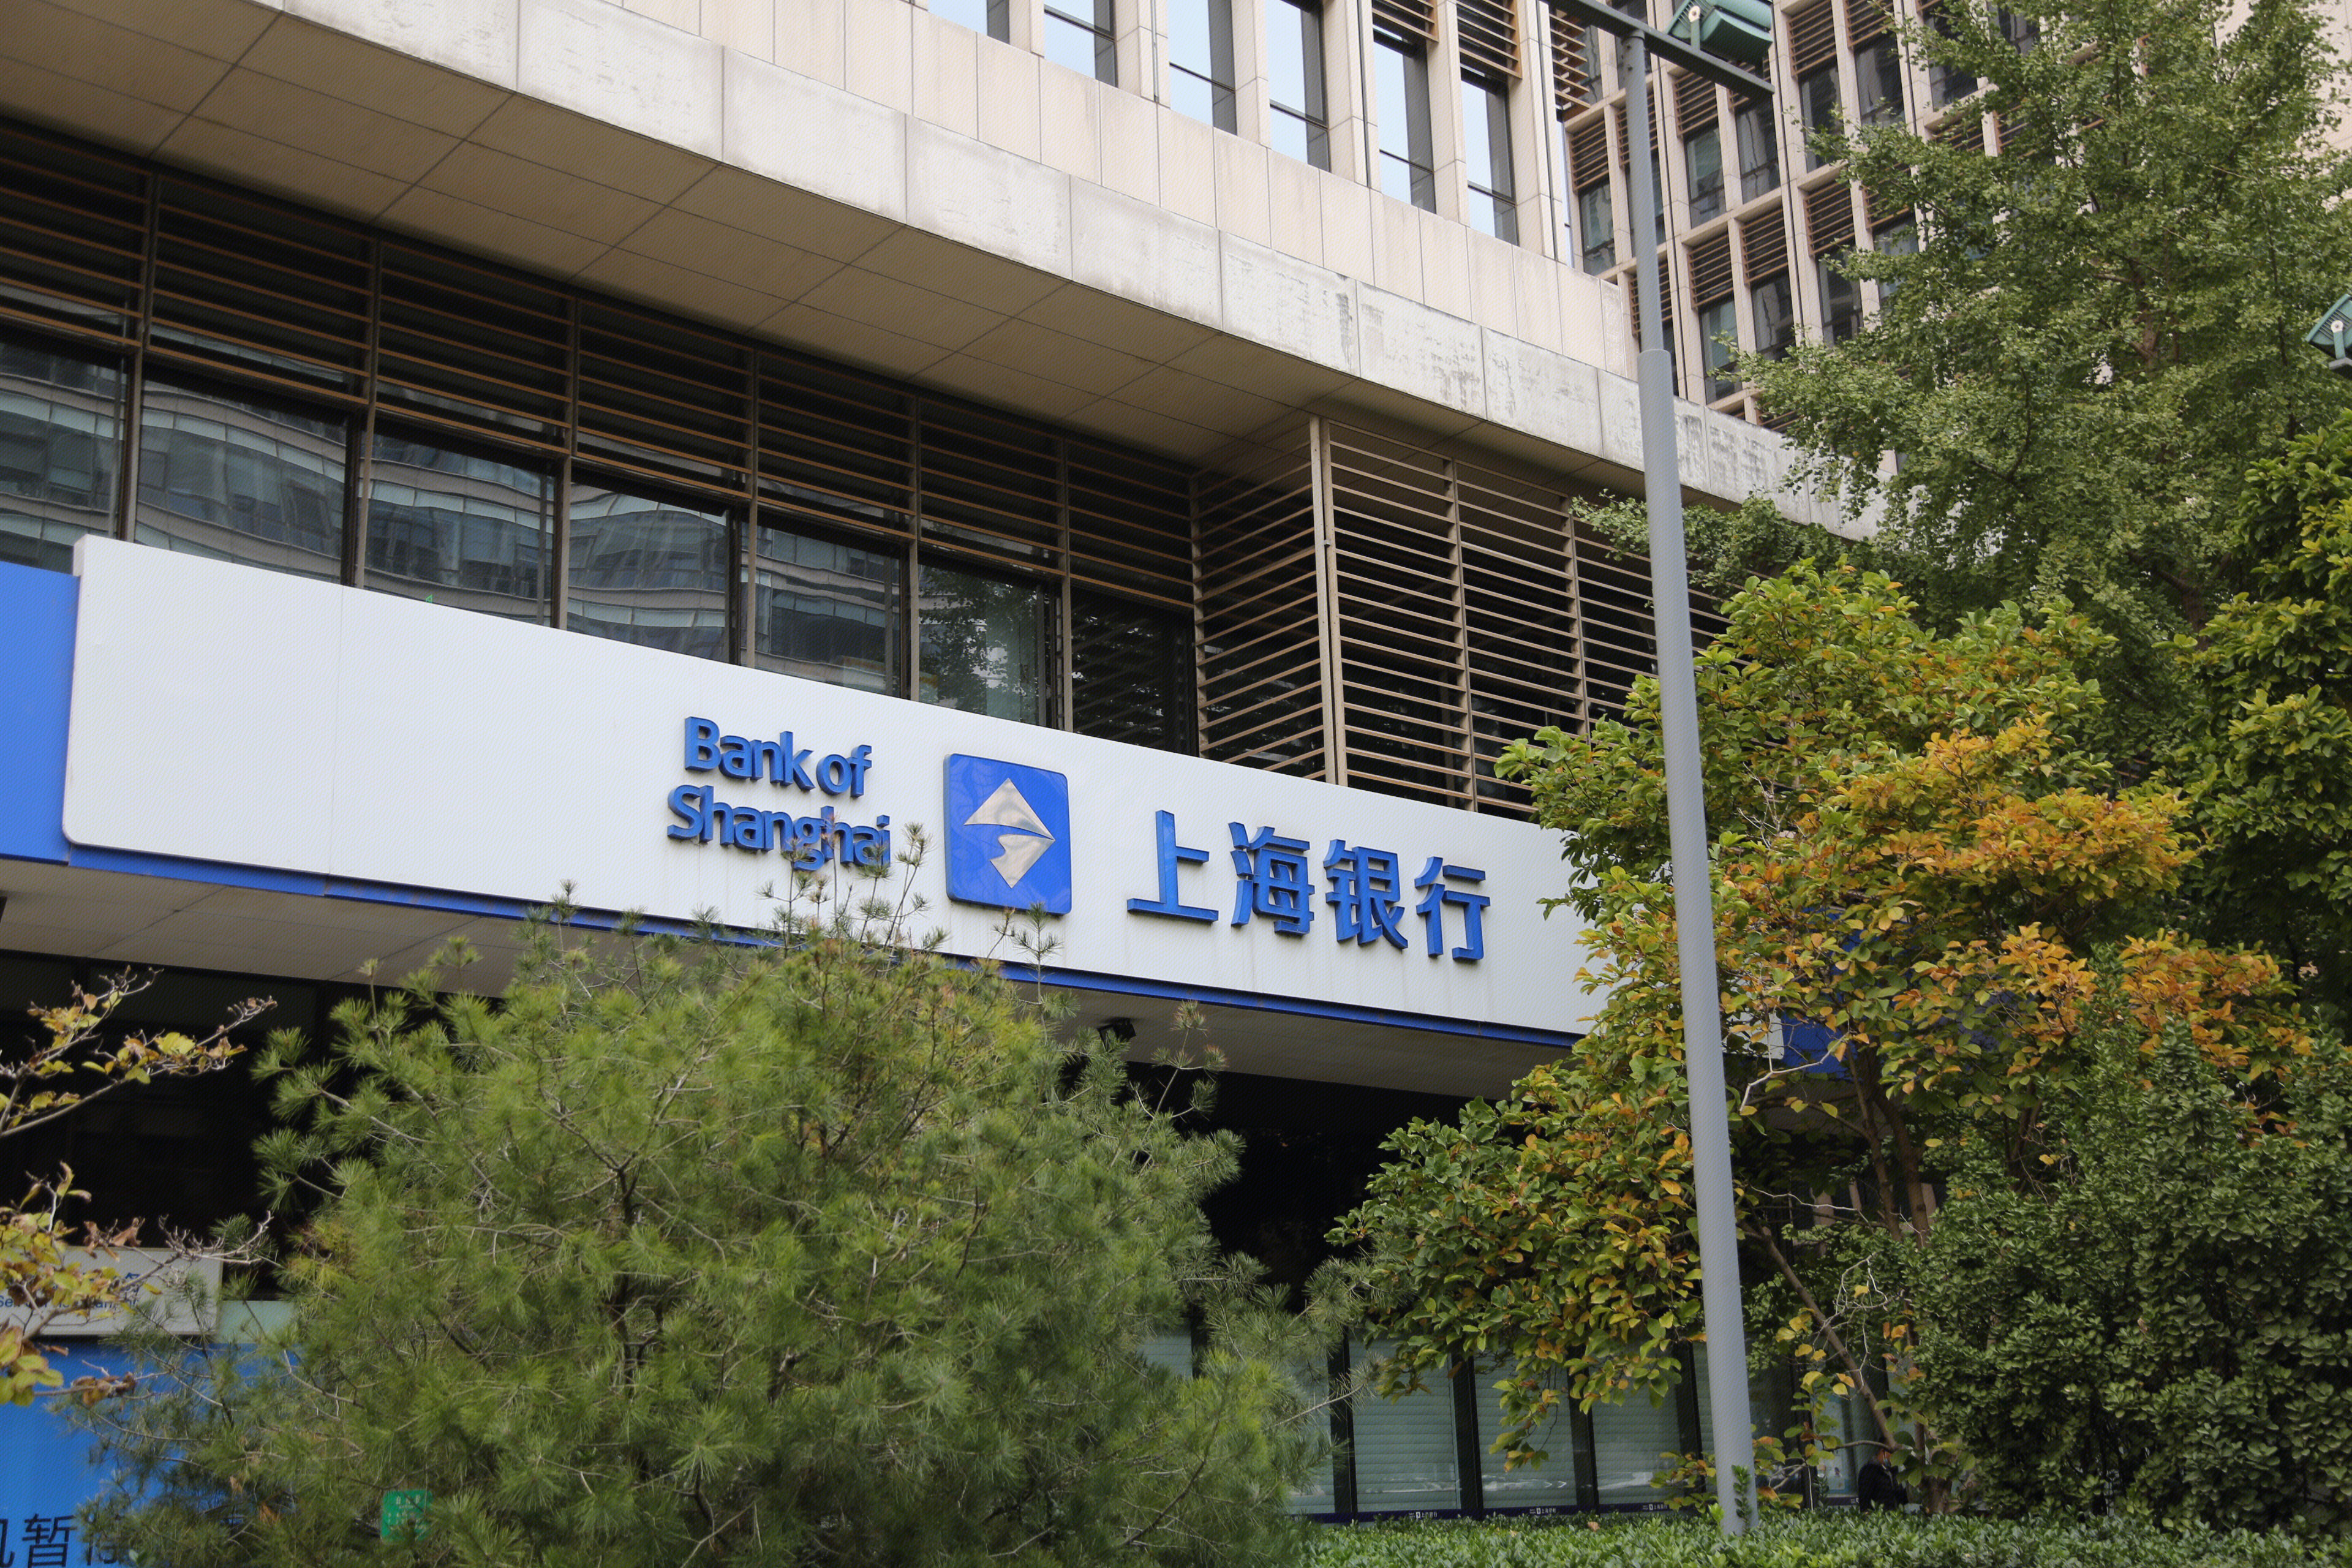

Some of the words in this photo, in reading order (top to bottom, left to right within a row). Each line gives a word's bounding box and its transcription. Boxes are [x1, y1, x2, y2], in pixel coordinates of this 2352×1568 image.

[684, 716, 814, 791] Bank
[816, 744, 872, 797] of
[667, 784, 891, 872] Shanghai
[1127, 809, 1491, 961] 上海银行
